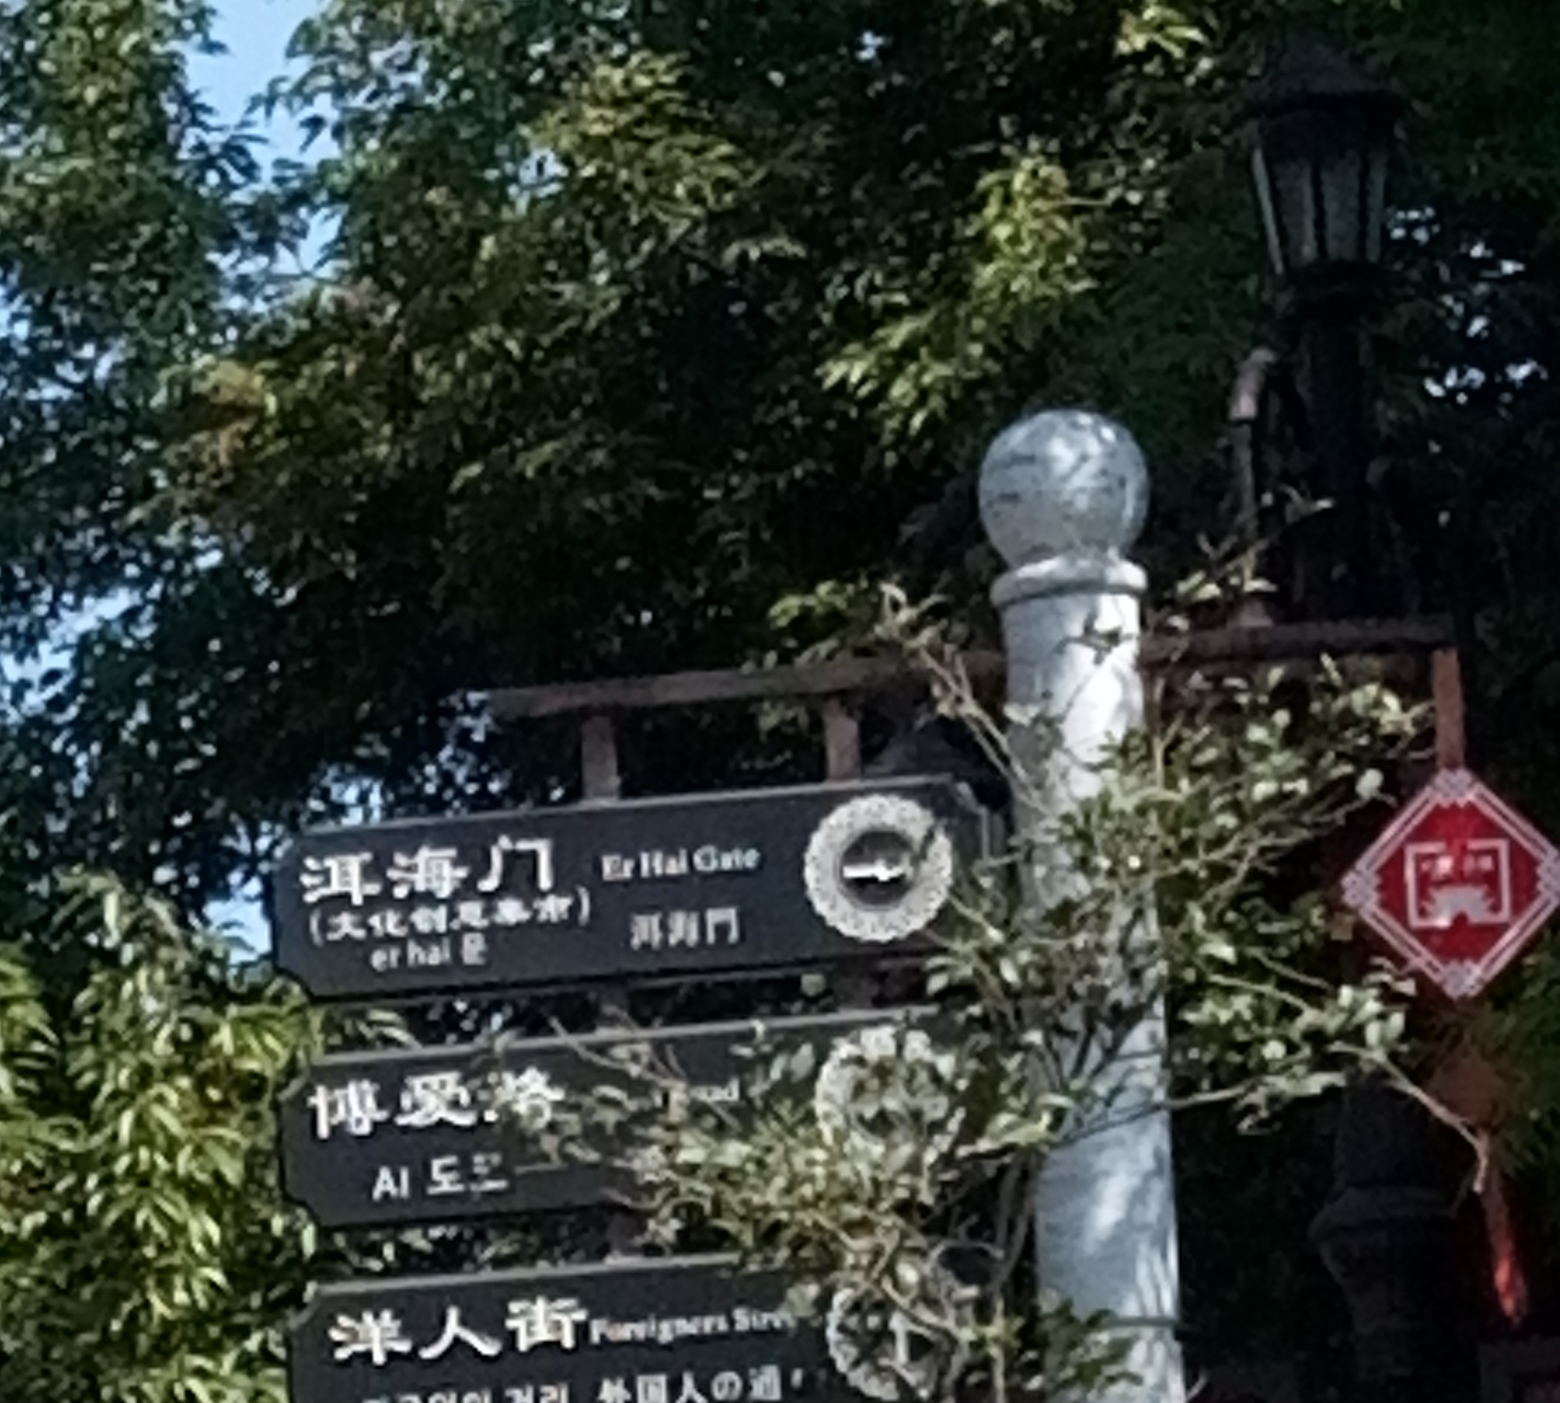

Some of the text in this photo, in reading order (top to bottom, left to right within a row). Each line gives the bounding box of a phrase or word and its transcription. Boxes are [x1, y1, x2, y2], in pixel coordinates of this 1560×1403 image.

[299, 834, 554, 906] 洱海门
[601, 854, 635, 881] Er
[692, 845, 761, 872] Gate
[328, 1295, 588, 1366] 洋人街
[590, 1314, 730, 1345] Foreigners
